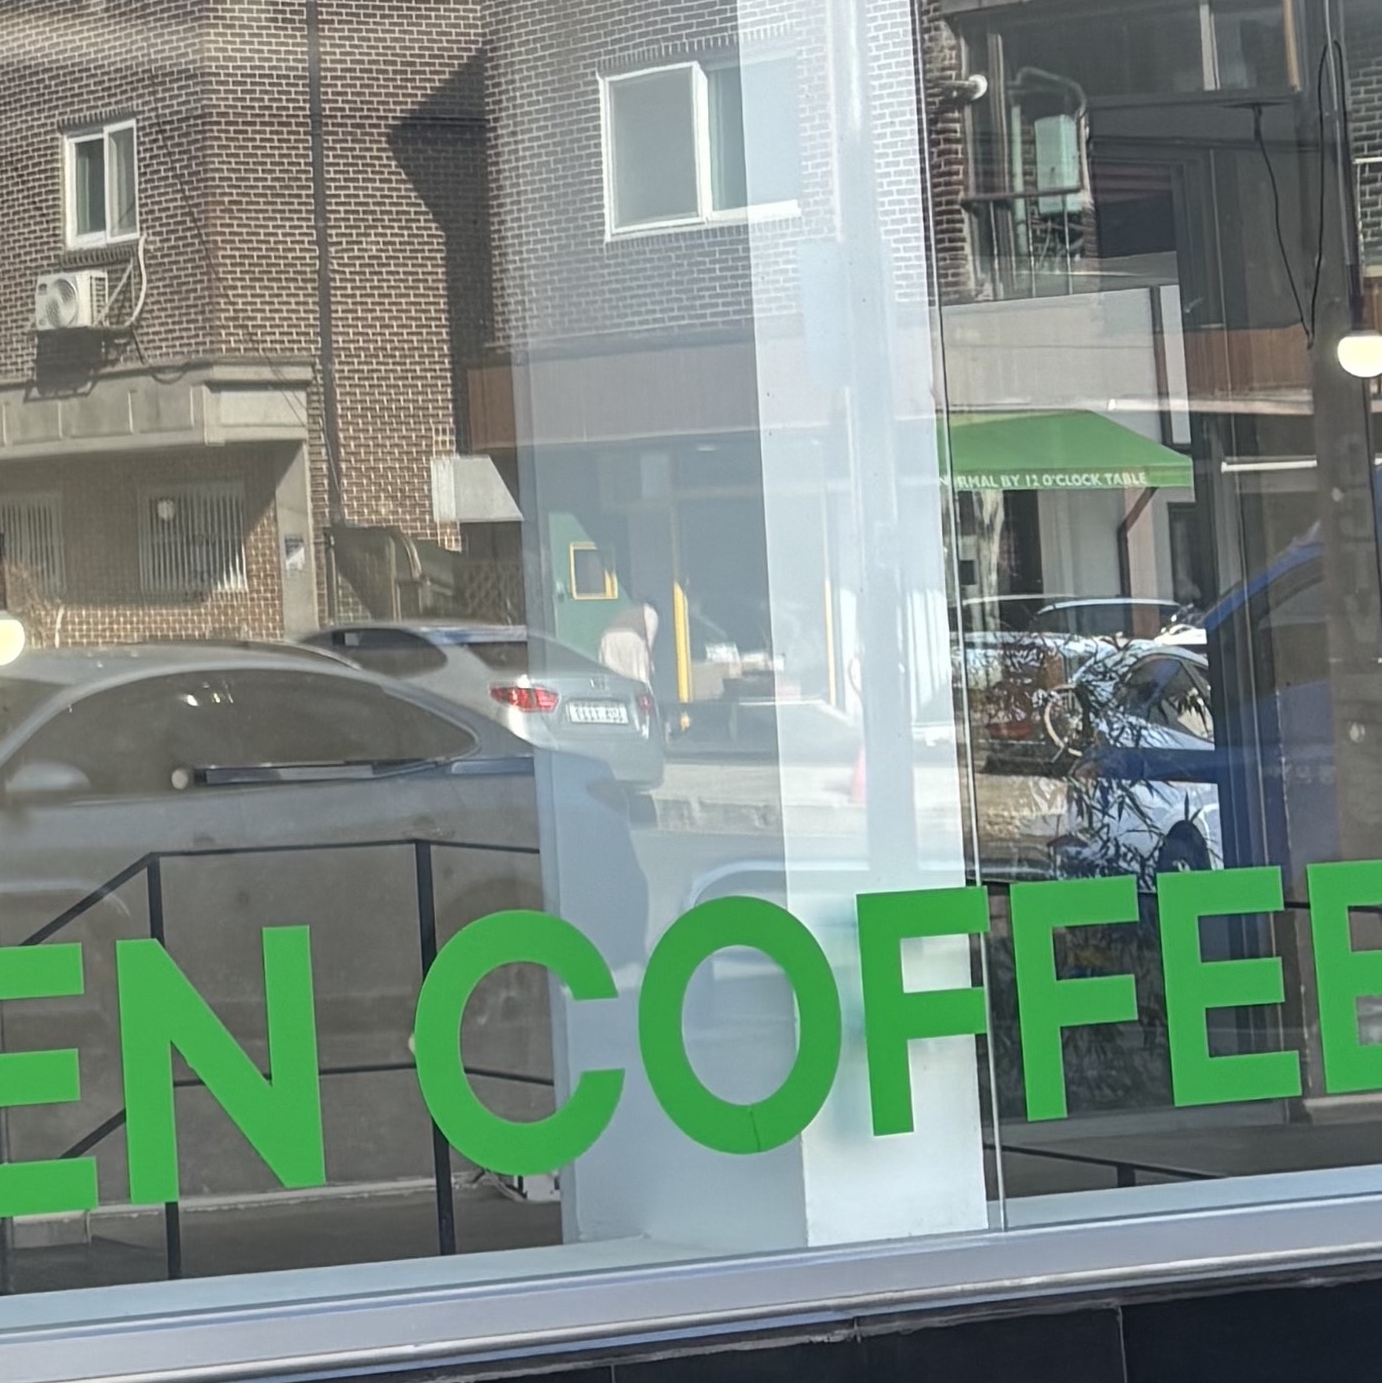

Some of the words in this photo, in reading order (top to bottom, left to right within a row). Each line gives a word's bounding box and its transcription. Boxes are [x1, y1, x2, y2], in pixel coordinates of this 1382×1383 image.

[1000, 474, 1020, 487] BY
[1104, 472, 1148, 486] TABLE
[414, 861, 1382, 1176] COFFEE
